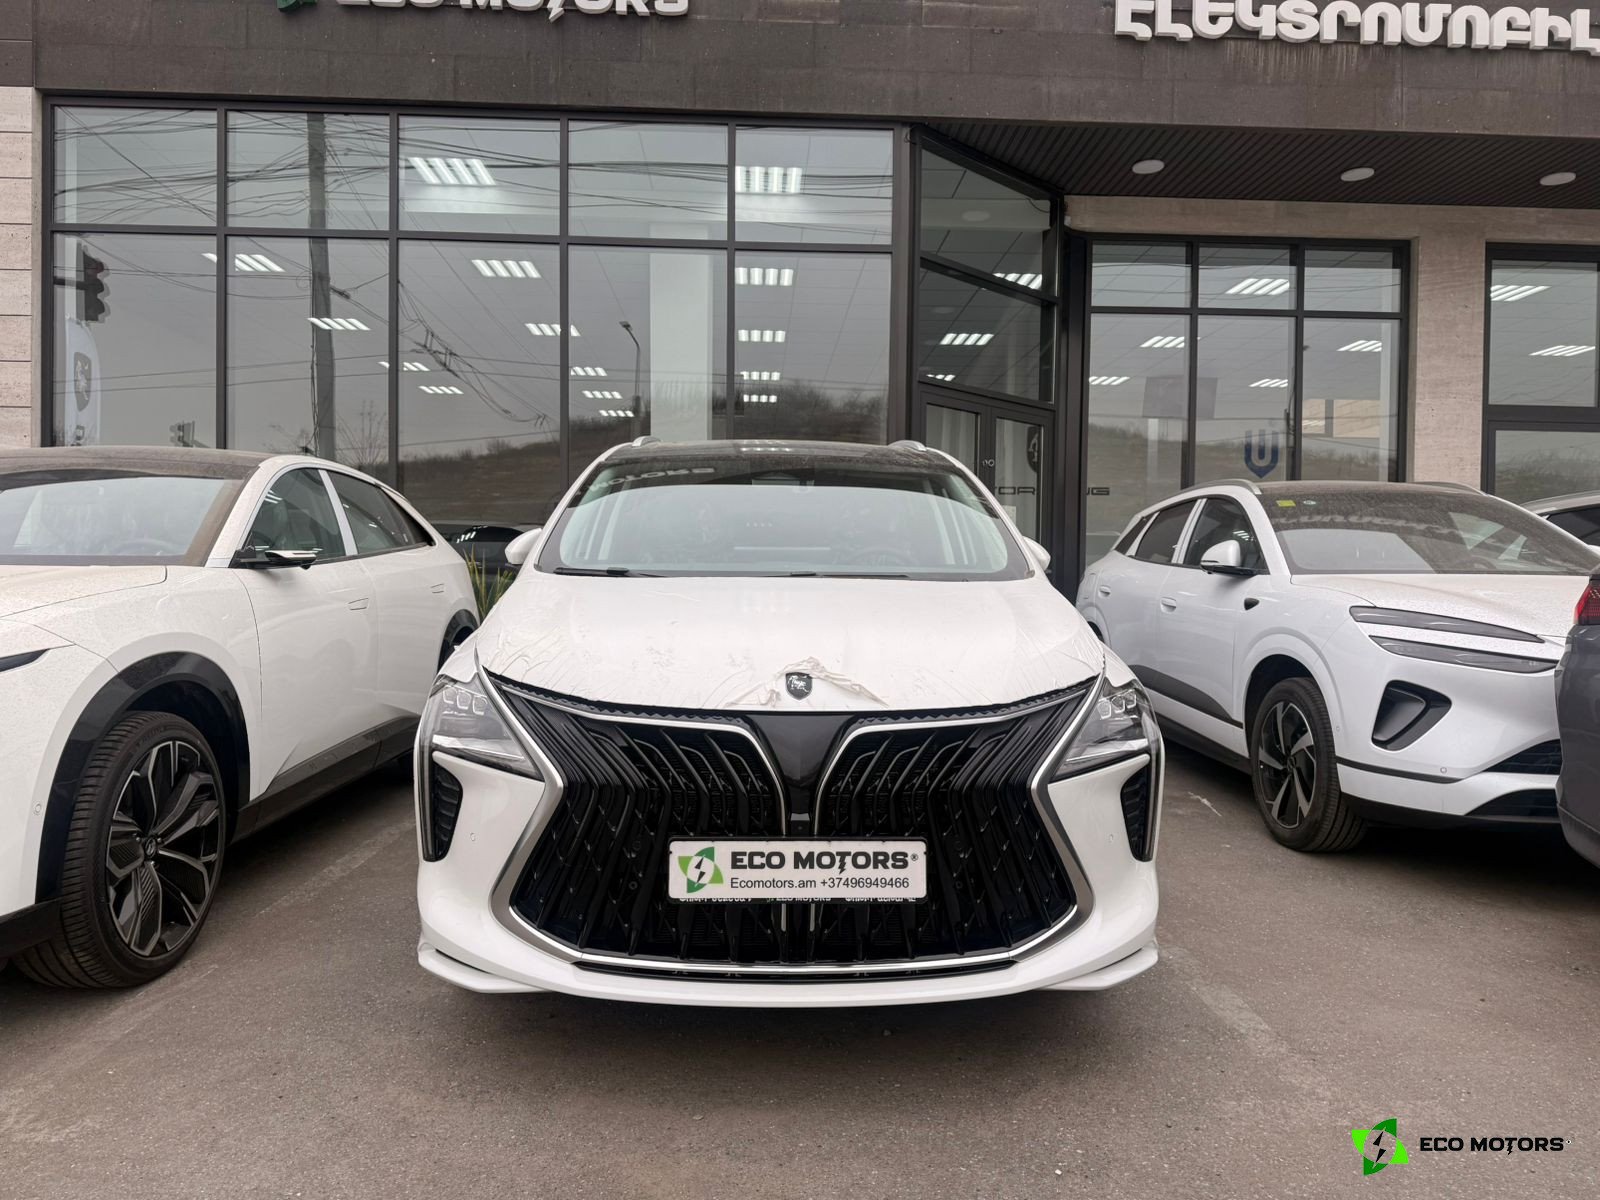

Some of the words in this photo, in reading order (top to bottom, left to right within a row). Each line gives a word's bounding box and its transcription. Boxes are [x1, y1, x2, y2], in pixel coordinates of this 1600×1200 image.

[731, 851, 786, 870] ECO
[730, 877, 817, 889] Ecomotors.am
[820, 877, 910, 889] +37496949466
